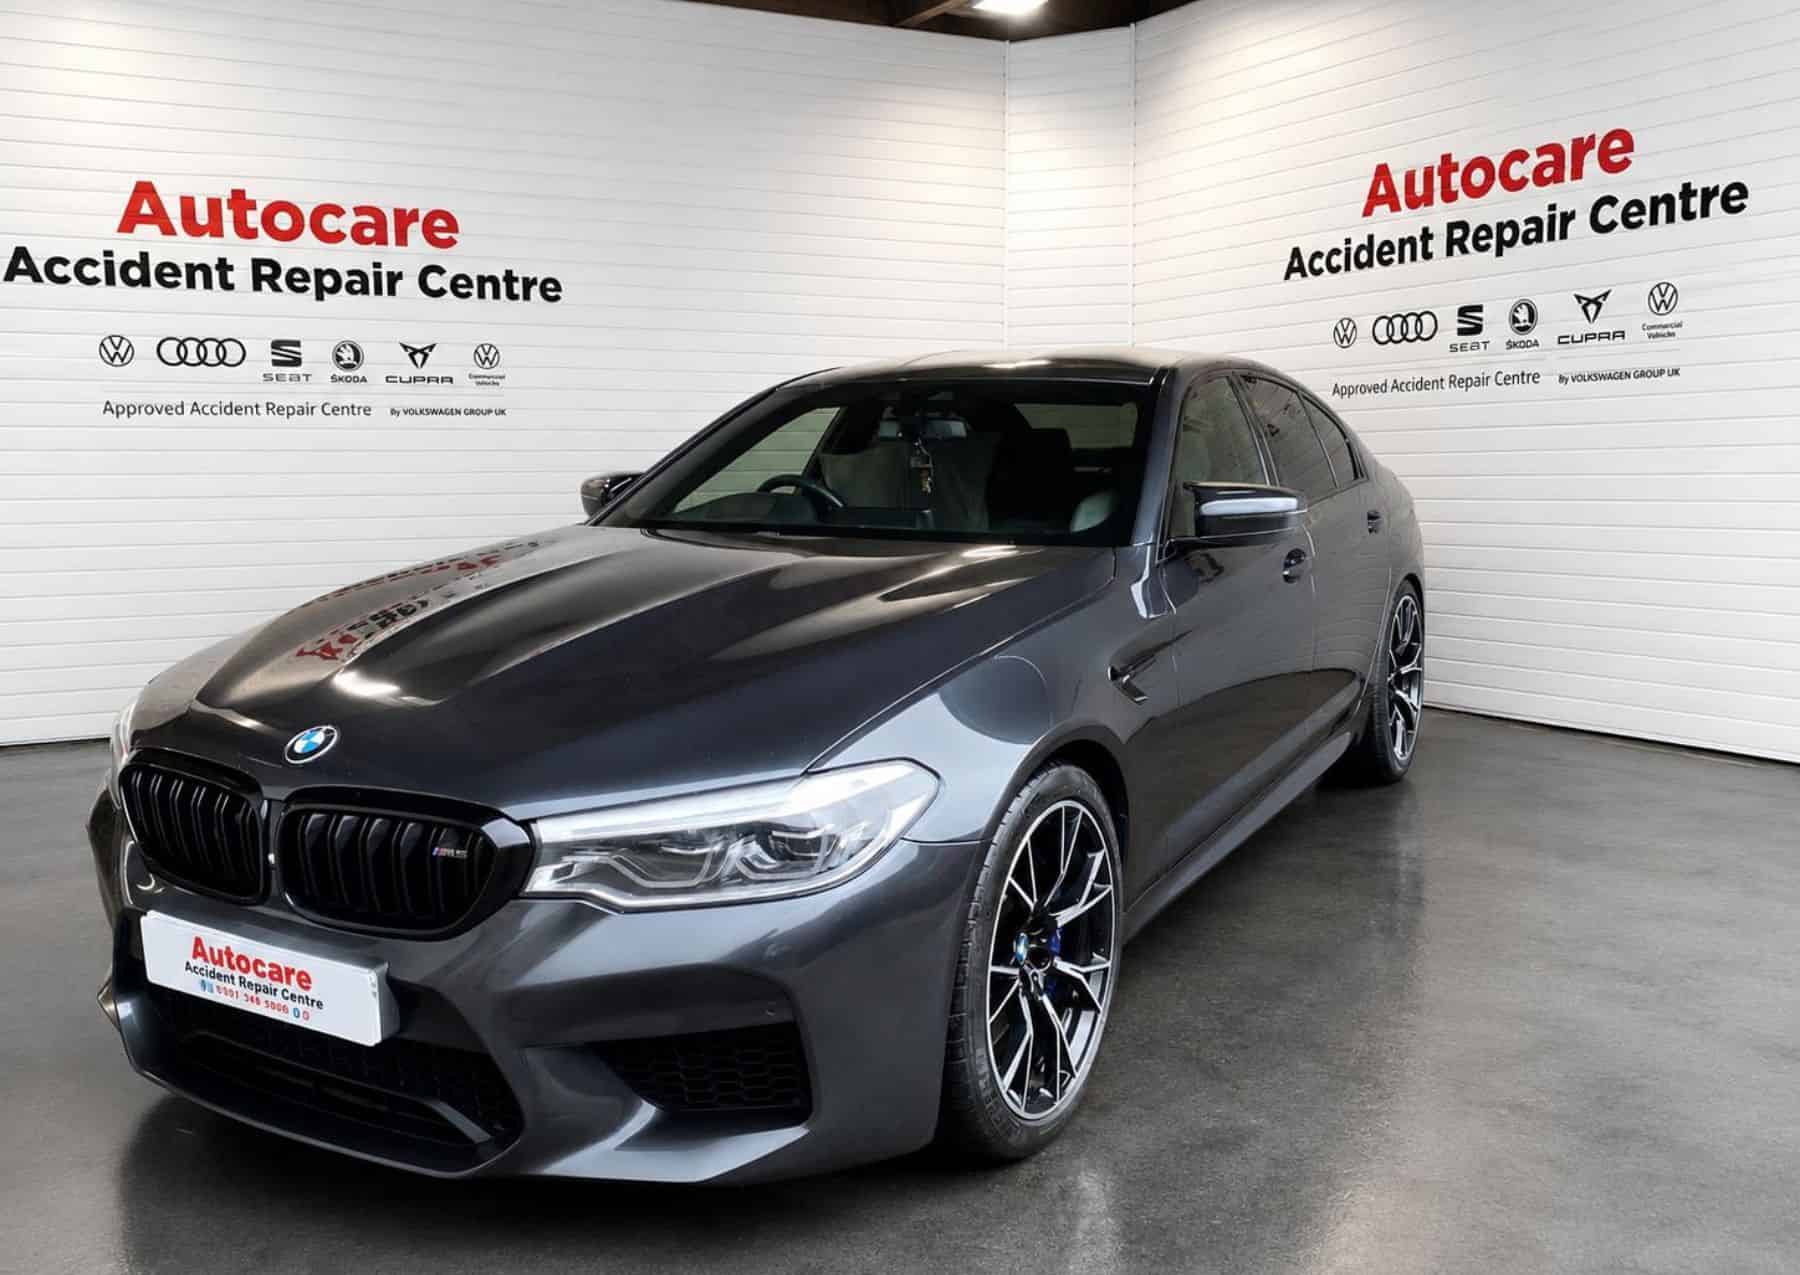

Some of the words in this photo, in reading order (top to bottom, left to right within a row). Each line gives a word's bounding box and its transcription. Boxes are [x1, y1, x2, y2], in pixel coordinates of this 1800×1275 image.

[1362, 129, 1634, 218] Autocare
[117, 181, 459, 249] Autocare
[1284, 226, 1434, 281] Accident
[1446, 203, 1576, 258] Repair
[1589, 181, 1749, 234] Centre
[3, 246, 235, 292] Accident
[251, 257, 404, 302] Repair
[417, 264, 563, 302] Centre
[1449, 340, 1490, 352] SEAT
[1557, 330, 1626, 345] CUPRA
[262, 373, 312, 382] SEAT
[385, 375, 454, 385] CUPRA
[1332, 379, 1388, 399] Approved
[1391, 376, 1445, 393] Accident
[1449, 371, 1491, 391] Repair
[1494, 370, 1541, 386] Centre
[1571, 370, 1631, 383] VOLKSWAGEN
[1633, 368, 1665, 380] GROUP
[102, 401, 185, 419] Approved
[190, 401, 261, 416] Accident
[265, 401, 316, 419] Repair
[320, 401, 372, 416] Centre
[402, 407, 461, 417] VOLKSWAGEN
[463, 407, 493, 417] GROUP
[192, 936, 312, 991] Autocare
[185, 961, 235, 986] Accident
[238, 975, 278, 997] Repair
[281, 988, 324, 1010] Centre
